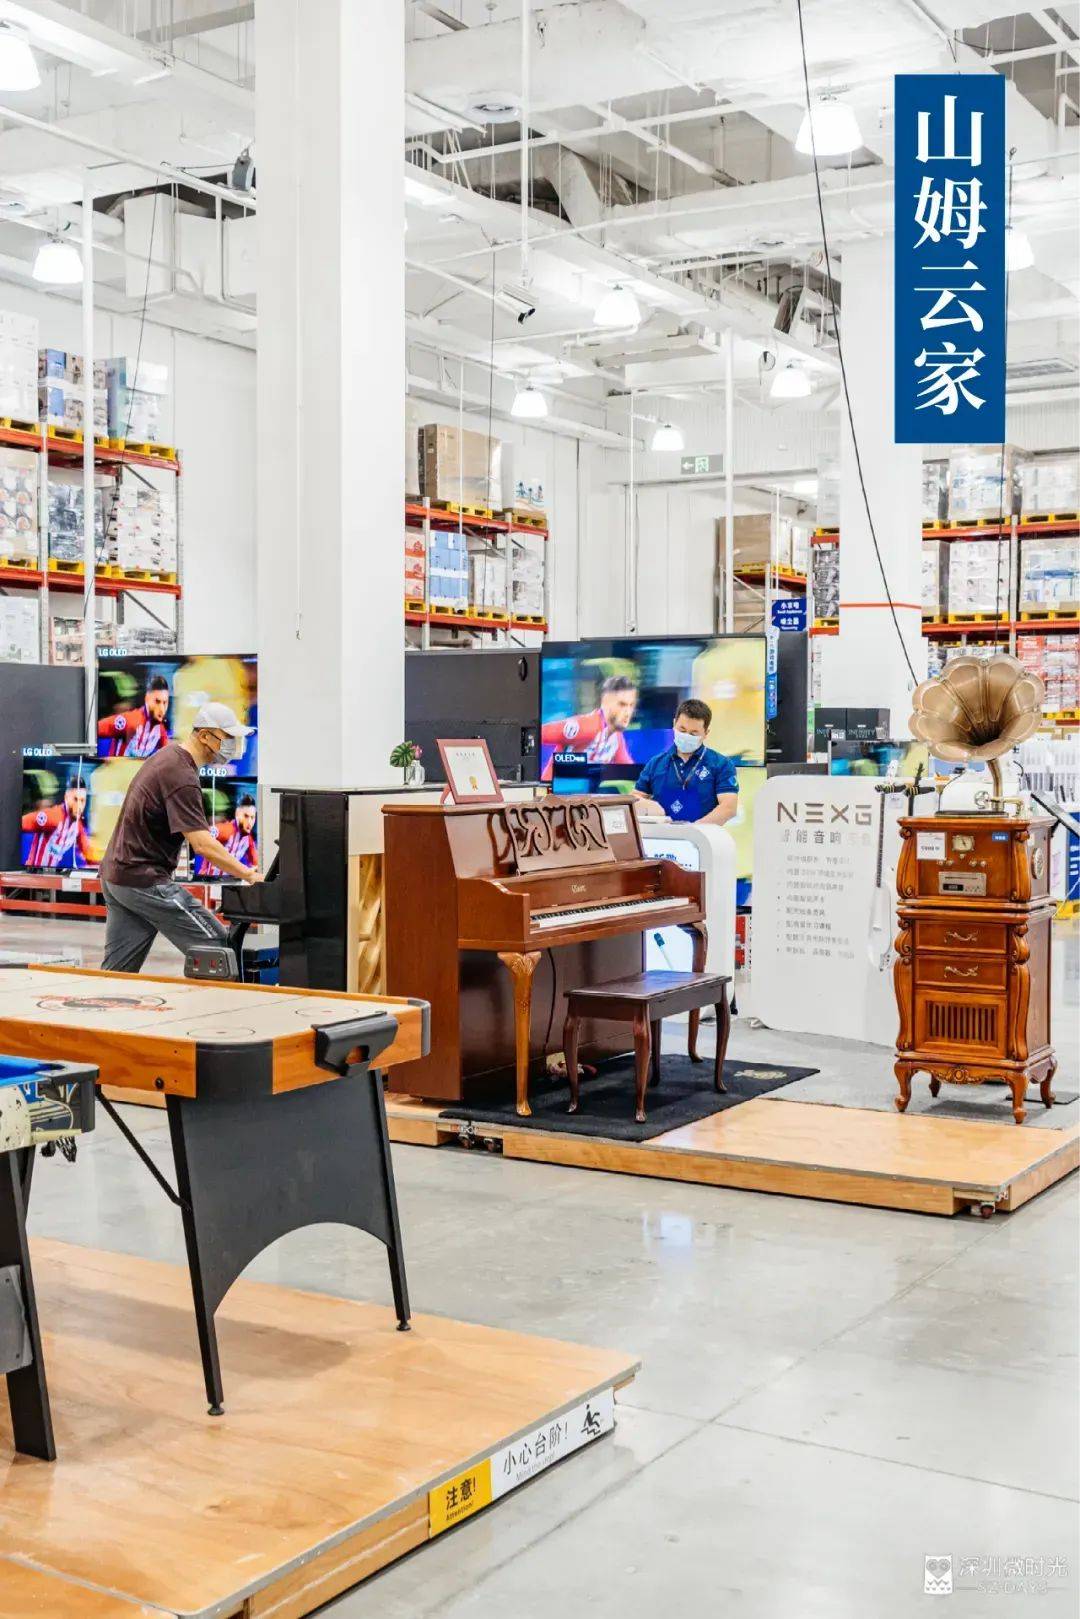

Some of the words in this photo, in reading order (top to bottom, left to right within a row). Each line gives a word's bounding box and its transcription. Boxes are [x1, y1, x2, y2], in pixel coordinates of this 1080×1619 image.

[98, 648, 109, 657] LG
[109, 648, 128, 657] OLED
[23, 747, 33, 757] LG
[555, 754, 575, 763] OLED
[207, 767, 228, 777] OLED
[776, 801, 873, 826] NEXG
[446, 1476, 476, 1511] 注意!
